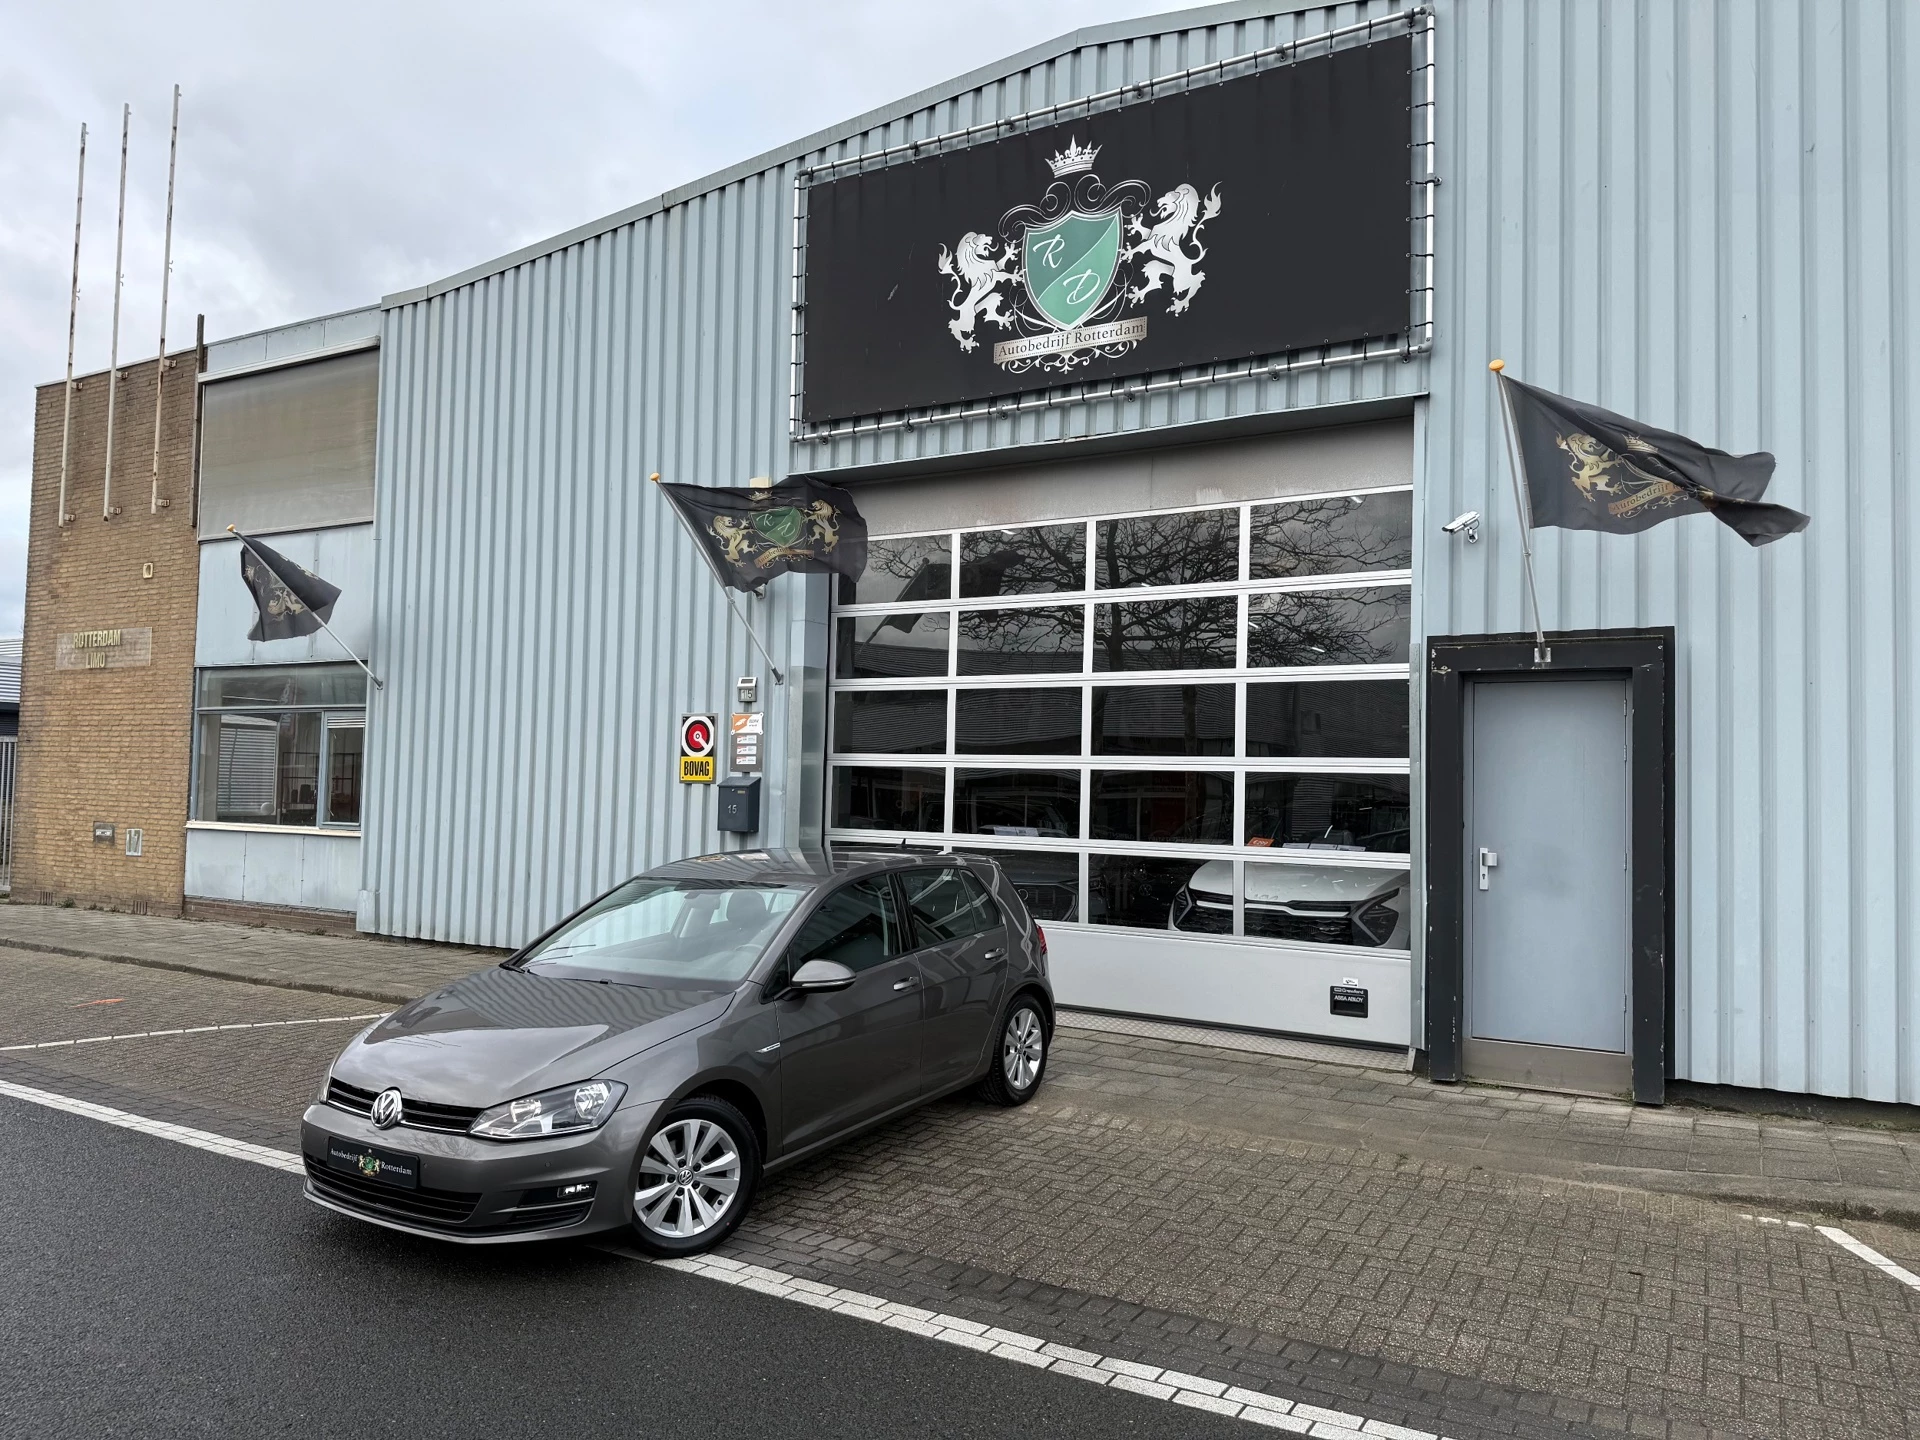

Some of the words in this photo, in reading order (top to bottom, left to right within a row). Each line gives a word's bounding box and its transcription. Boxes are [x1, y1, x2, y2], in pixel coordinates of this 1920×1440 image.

[997, 331, 1073, 357] Autobedrijf
[1074, 322, 1145, 345] Rotterdam
[73, 629, 121, 649] ROTTERDAM
[85, 652, 106, 669] LIMO
[684, 760, 710, 777] BOVAG
[727, 804, 738, 814] 15
